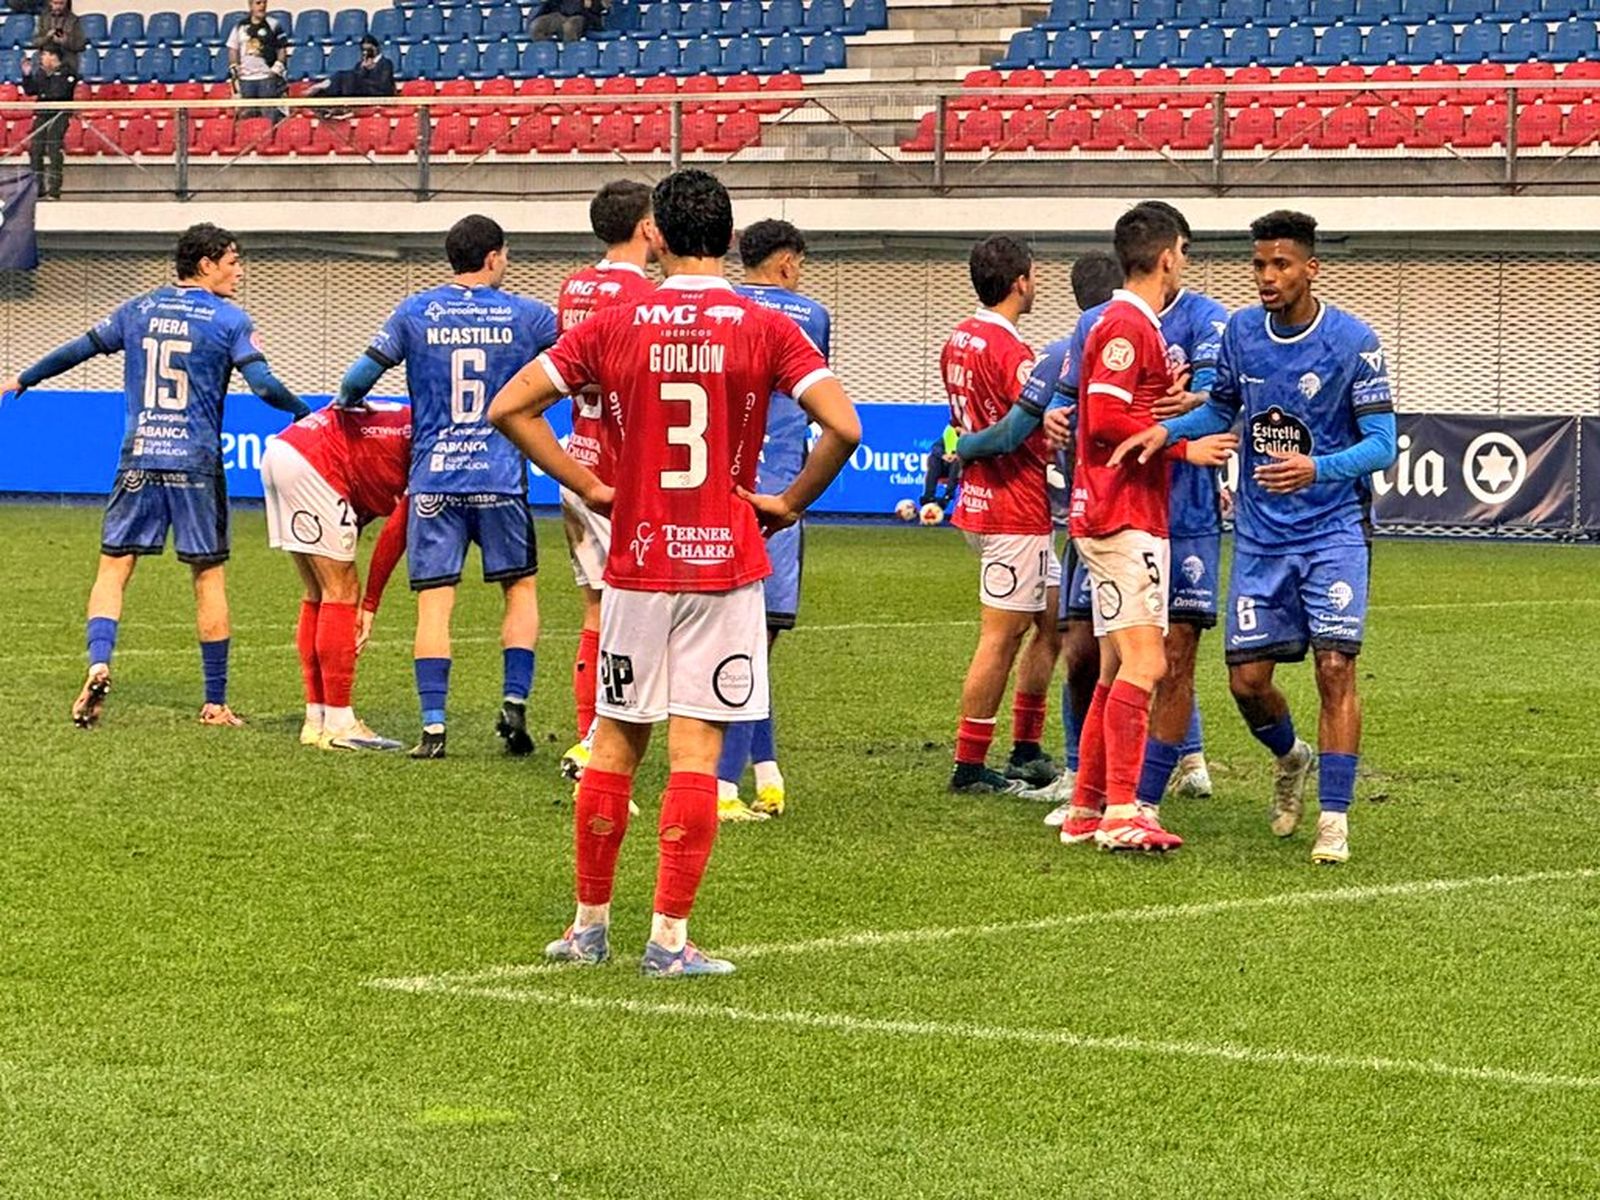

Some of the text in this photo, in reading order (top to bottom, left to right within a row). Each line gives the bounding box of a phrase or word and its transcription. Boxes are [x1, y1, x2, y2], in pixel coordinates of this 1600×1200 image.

[148, 316, 189, 336] PIERA
[632, 304, 698, 326] MMG
[649, 338, 725, 374] GORJÓN
[142, 336, 193, 411] 15
[451, 348, 487, 424] 6
[135, 425, 190, 440] ABANCA
[659, 382, 709, 490] 3
[1252, 422, 1300, 439] Estrella
[666, 541, 735, 559] CHARRA
[1142, 552, 1160, 585] 5
[1237, 595, 1257, 631] 6
